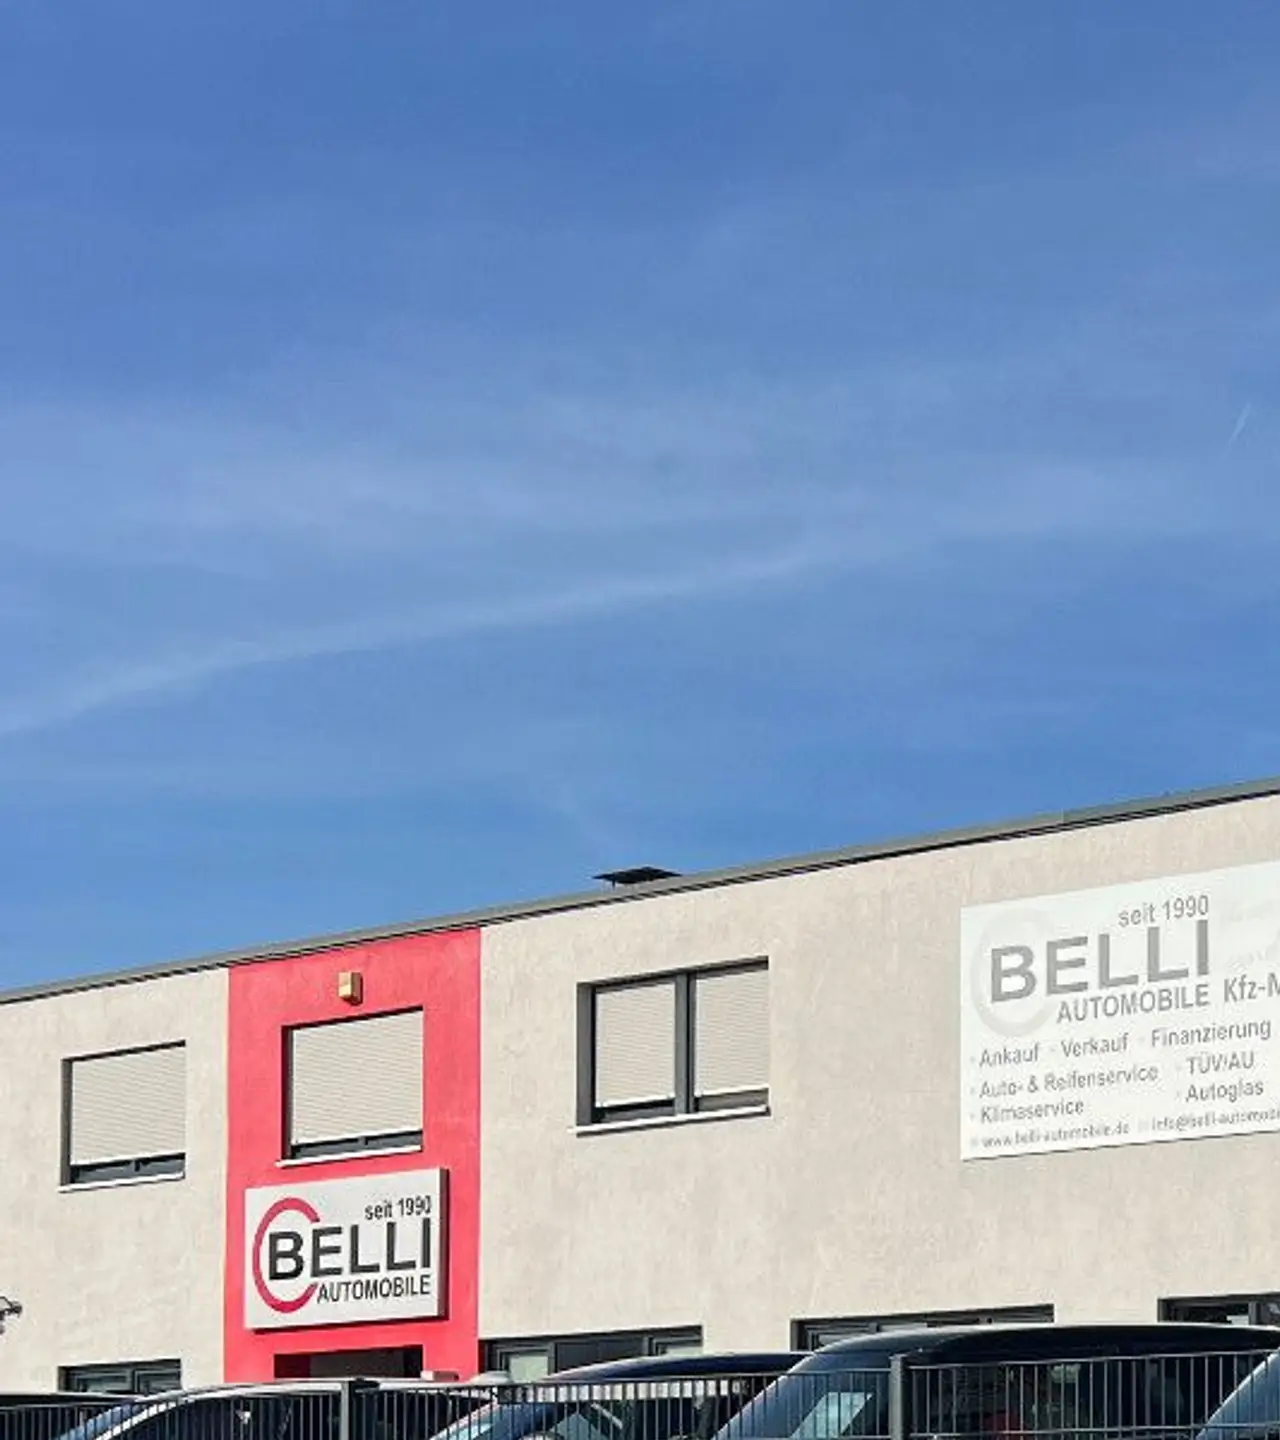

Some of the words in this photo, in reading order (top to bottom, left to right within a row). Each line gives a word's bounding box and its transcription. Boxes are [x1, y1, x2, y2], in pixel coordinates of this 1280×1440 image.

[1117, 900, 1157, 929] seit
[1162, 894, 1210, 921] 1990
[989, 918, 1210, 1004] BELLI
[1056, 983, 1210, 1024] AUTOMOBILE
[979, 1043, 1040, 1068] Ankauf
[1060, 1032, 1129, 1059] Verkauf
[1151, 1018, 1272, 1049] Finanzierung
[980, 1098, 1085, 1124] Klimaservice
[1185, 1079, 1264, 1105] Autoglas
[1026, 1071, 1040, 1094] &
[364, 1200, 393, 1221] seit
[397, 1195, 432, 1216] 1990
[268, 1217, 432, 1281] BELLI
[316, 1274, 431, 1304] AUTOMOBILE
